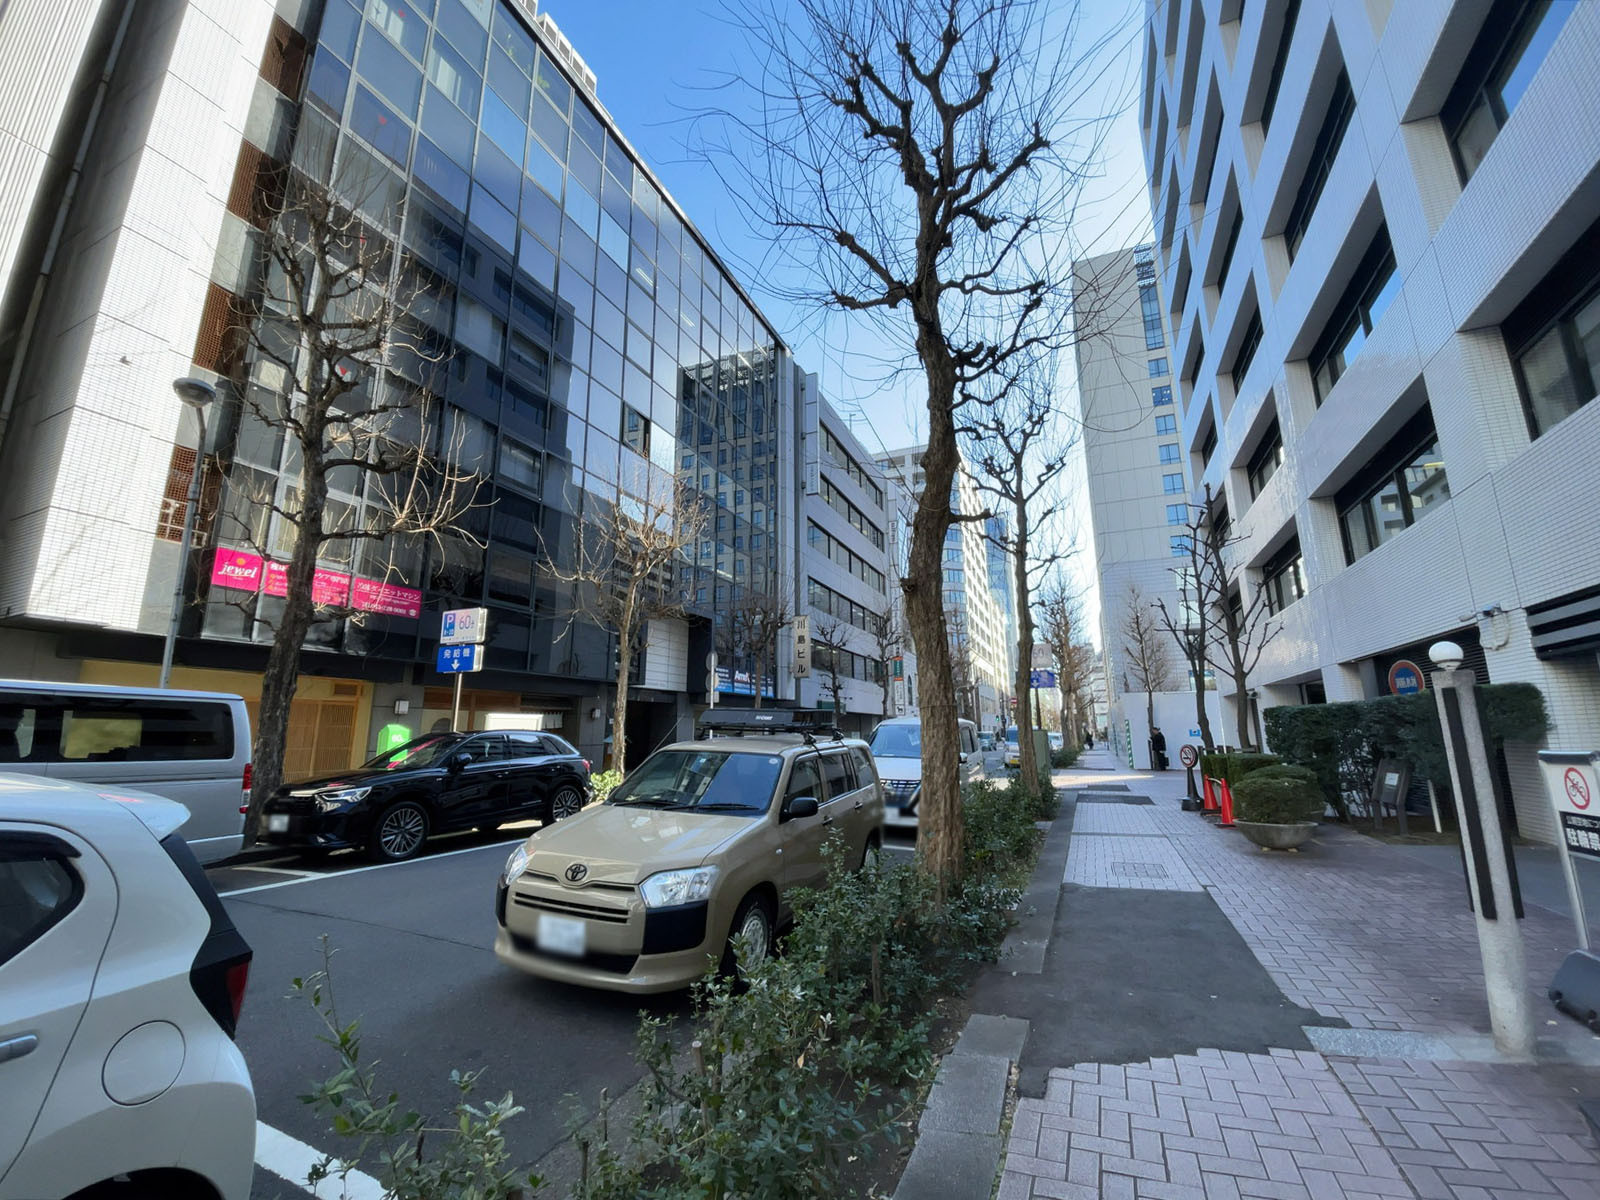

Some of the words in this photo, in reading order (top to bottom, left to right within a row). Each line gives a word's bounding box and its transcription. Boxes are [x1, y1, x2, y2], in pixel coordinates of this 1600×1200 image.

[218, 561, 258, 578] jewel
[443, 648, 470, 659] 発給機
[797, 619, 806, 673] 川島ビル
[1566, 828, 1600, 850] 駐輪禁
